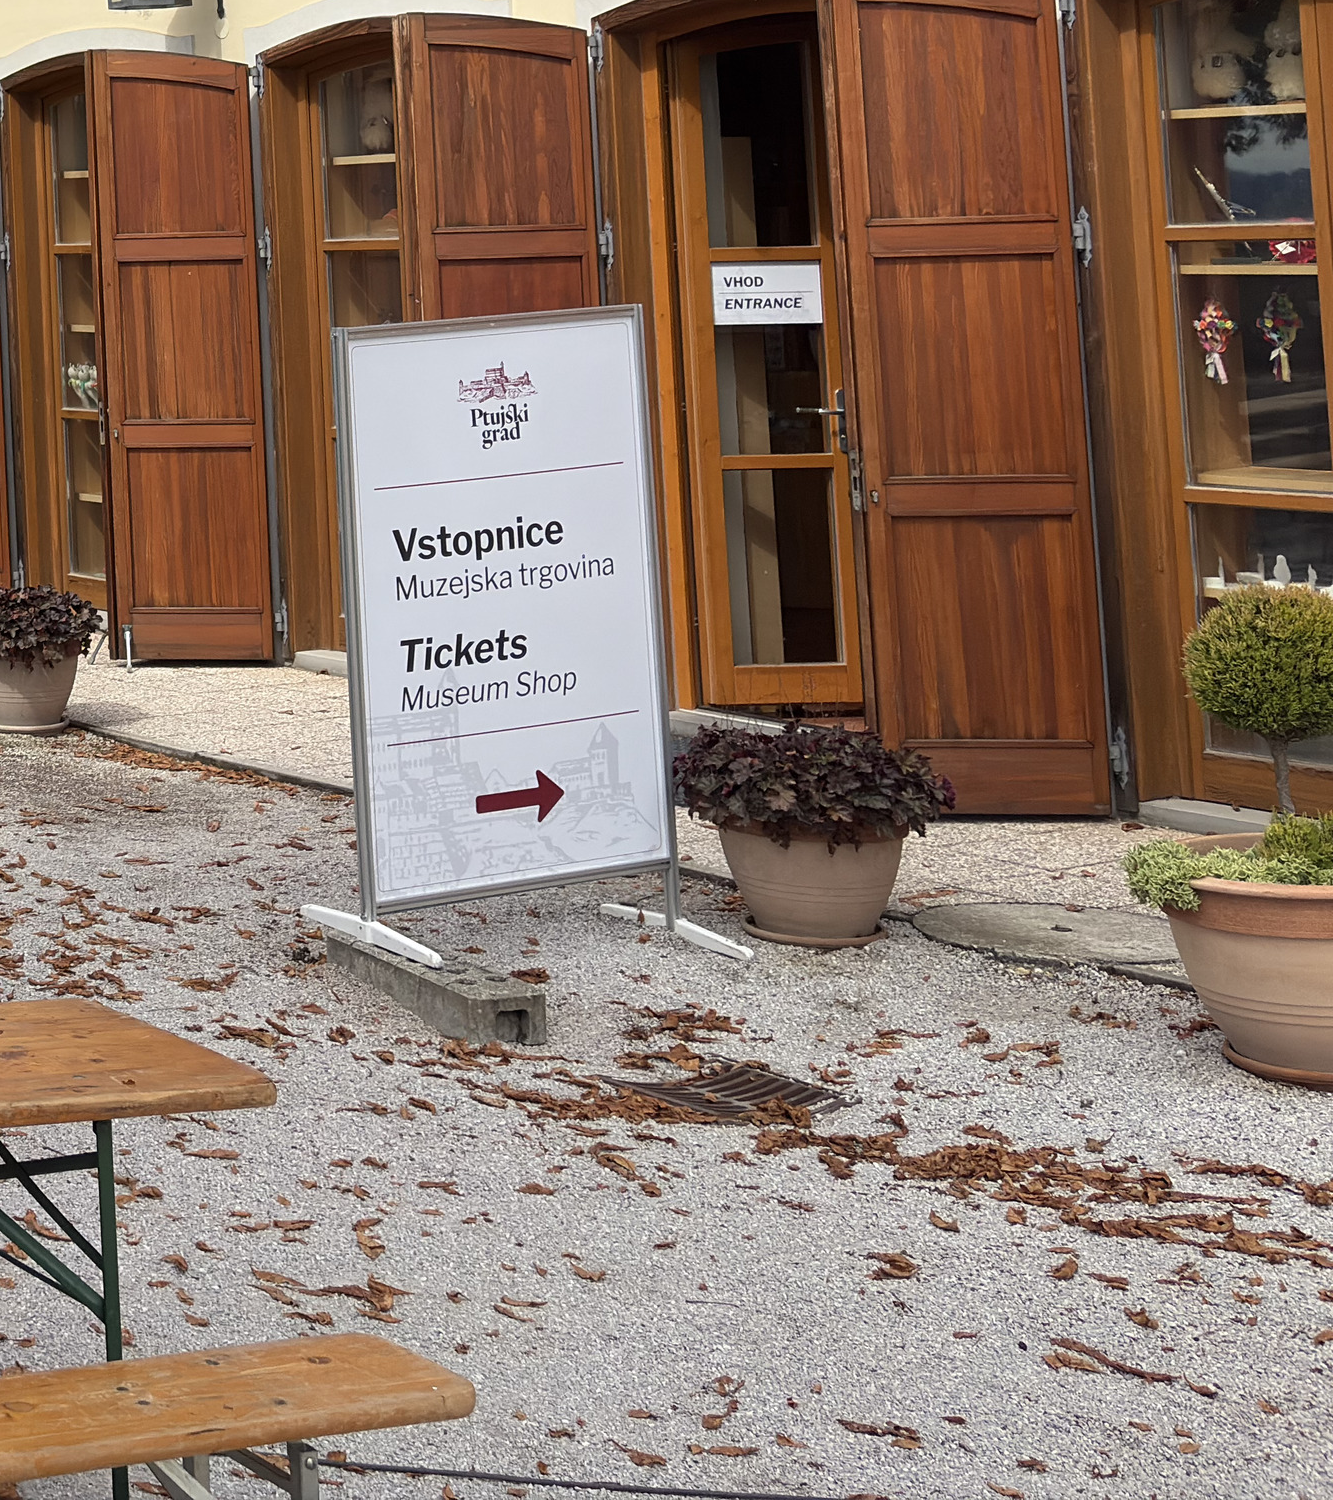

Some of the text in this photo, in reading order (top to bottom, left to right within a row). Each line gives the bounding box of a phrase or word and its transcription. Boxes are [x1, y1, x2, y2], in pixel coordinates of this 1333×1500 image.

[723, 275, 765, 288] VHOD
[724, 297, 803, 310] ENTRANCE
[470, 402, 529, 428] Ptujski
[481, 420, 521, 449] grad
[391, 515, 564, 562] Vstopnice
[394, 554, 615, 602] Muzejska trgovina
[399, 629, 529, 674] Tickets
[400, 670, 578, 713] Museum Shop
